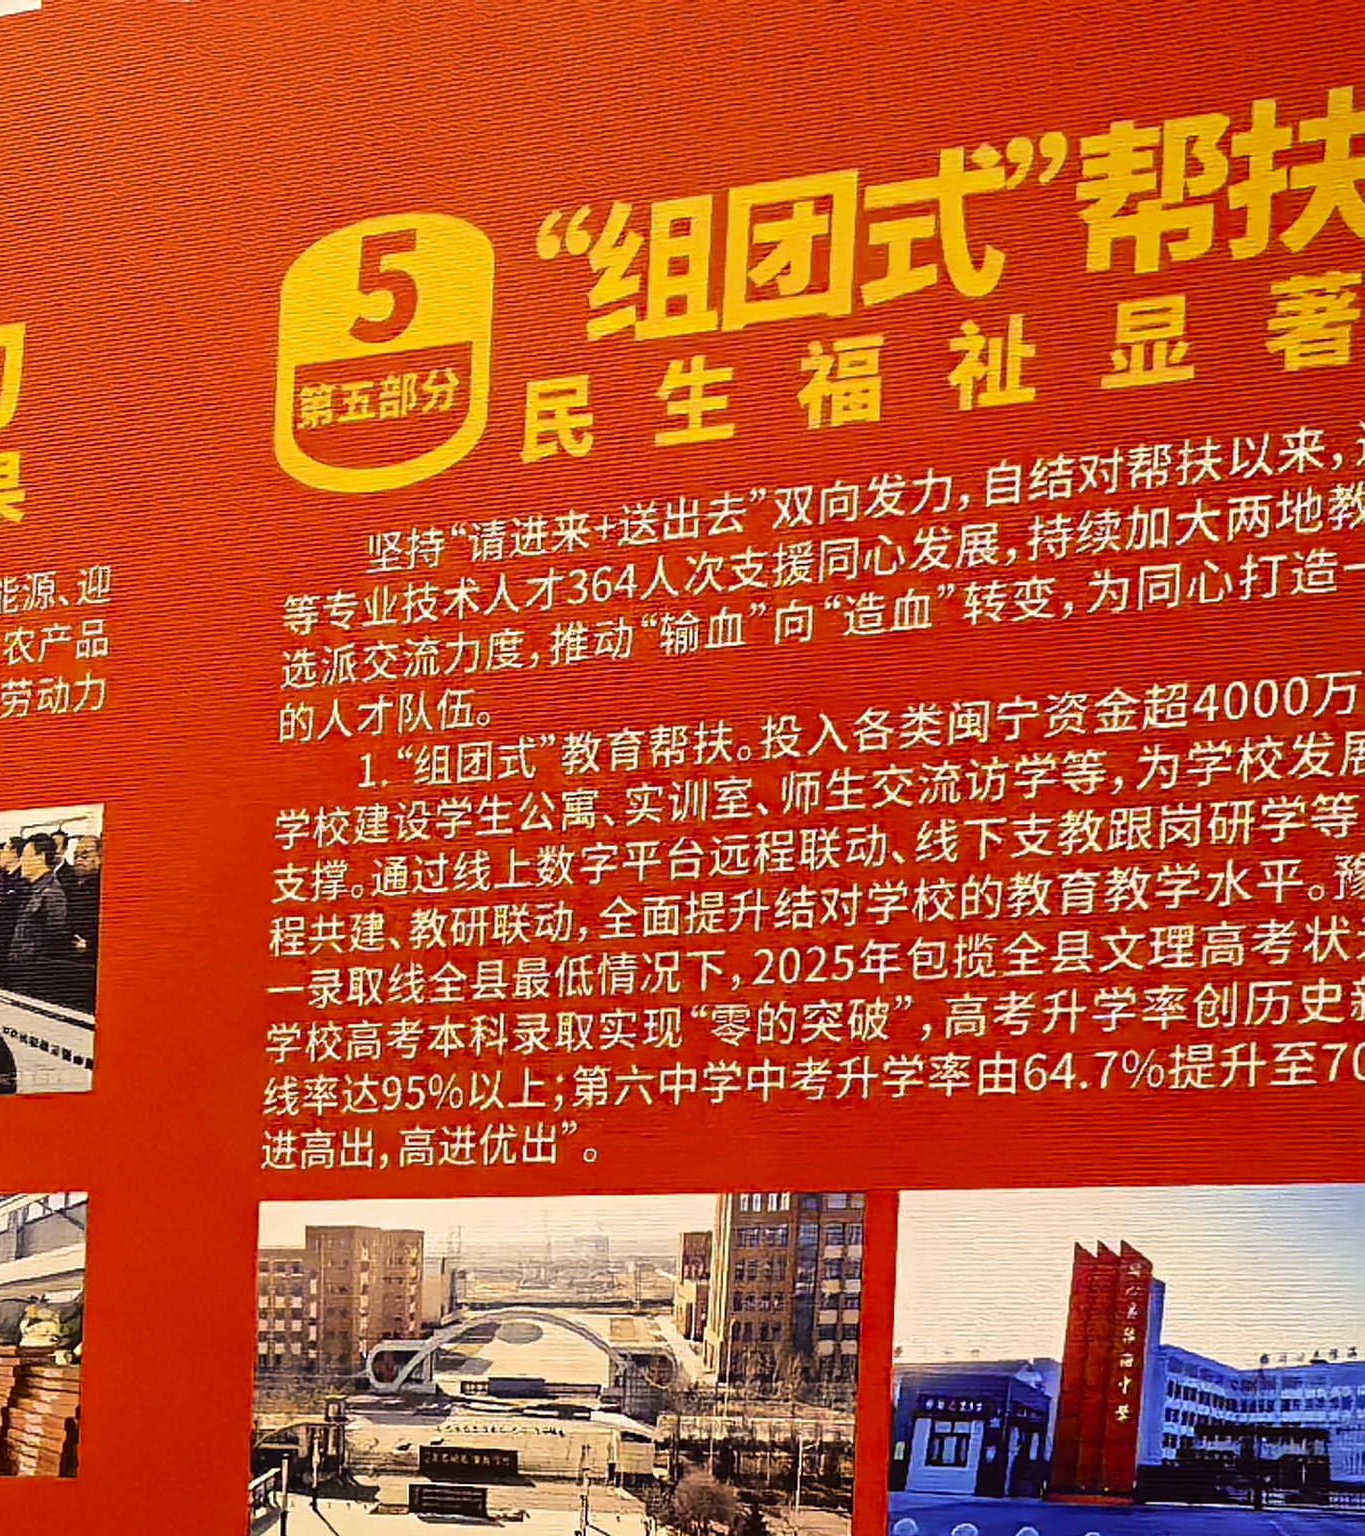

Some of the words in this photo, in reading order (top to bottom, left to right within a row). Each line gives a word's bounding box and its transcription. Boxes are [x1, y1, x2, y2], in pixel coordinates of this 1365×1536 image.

[534, 86, 1365, 341] “组团式”帮扶
[351, 227, 418, 341] 5
[296, 365, 460, 433] 第五部分
[520, 271, 1362, 463] 民生福祉显著
[367, 420, 1365, 570] 坚持“请进来+送出去”双向发力，自结对帮扶以来，
[279, 691, 493, 744] 的人才队伍。
[261, 1119, 599, 1171] 进高出，高进优出”。
